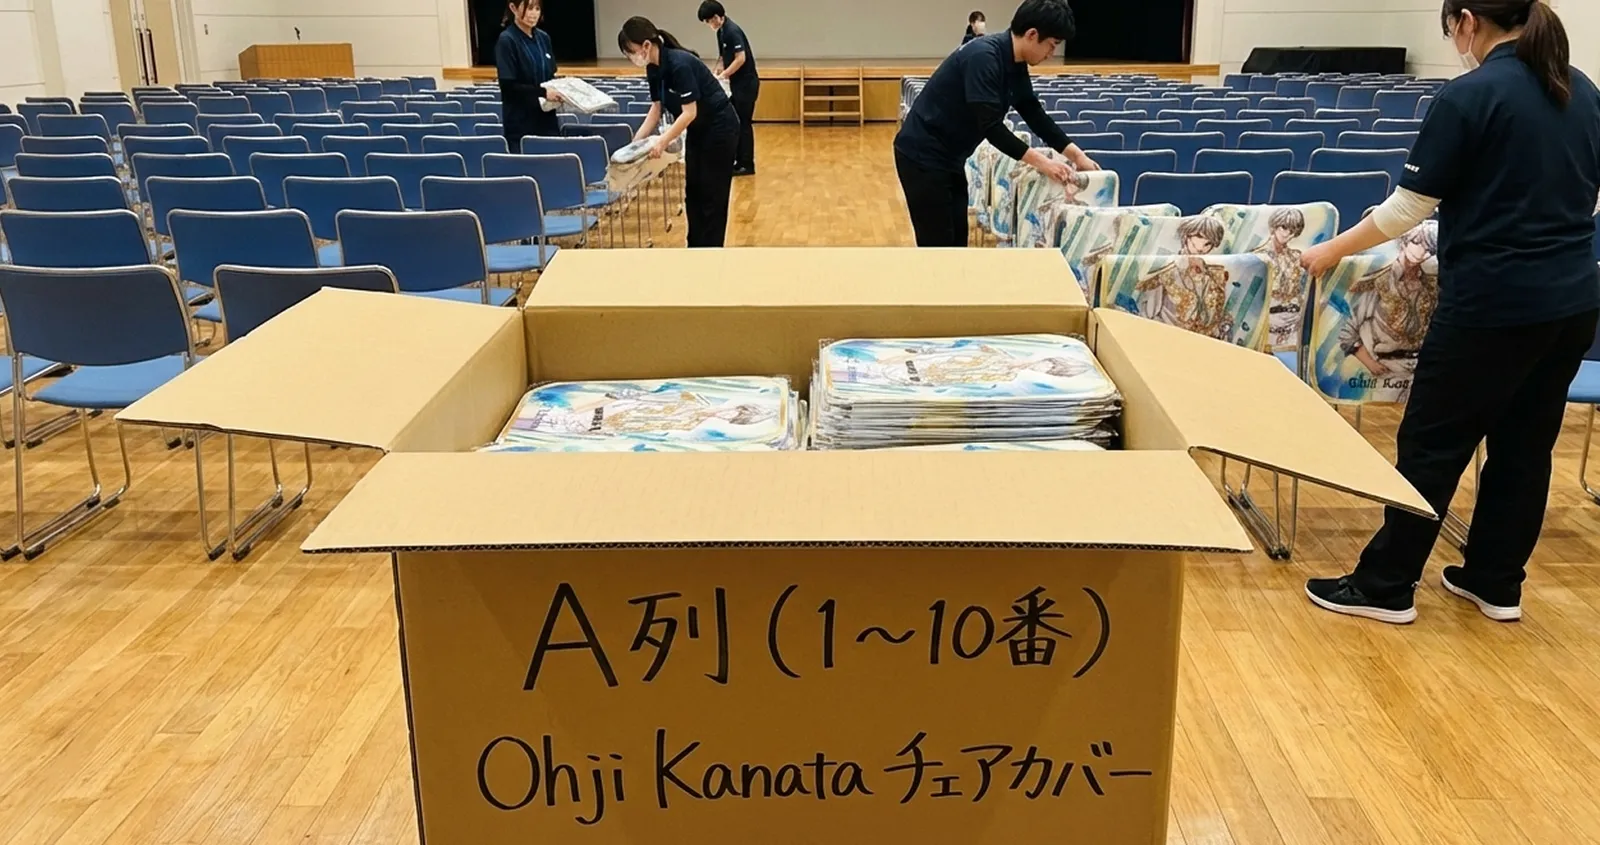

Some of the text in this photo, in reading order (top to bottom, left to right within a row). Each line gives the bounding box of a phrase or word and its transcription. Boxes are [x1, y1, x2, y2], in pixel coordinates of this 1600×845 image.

[477, 728, 1153, 825] Ohji Kanata チェアカバー
